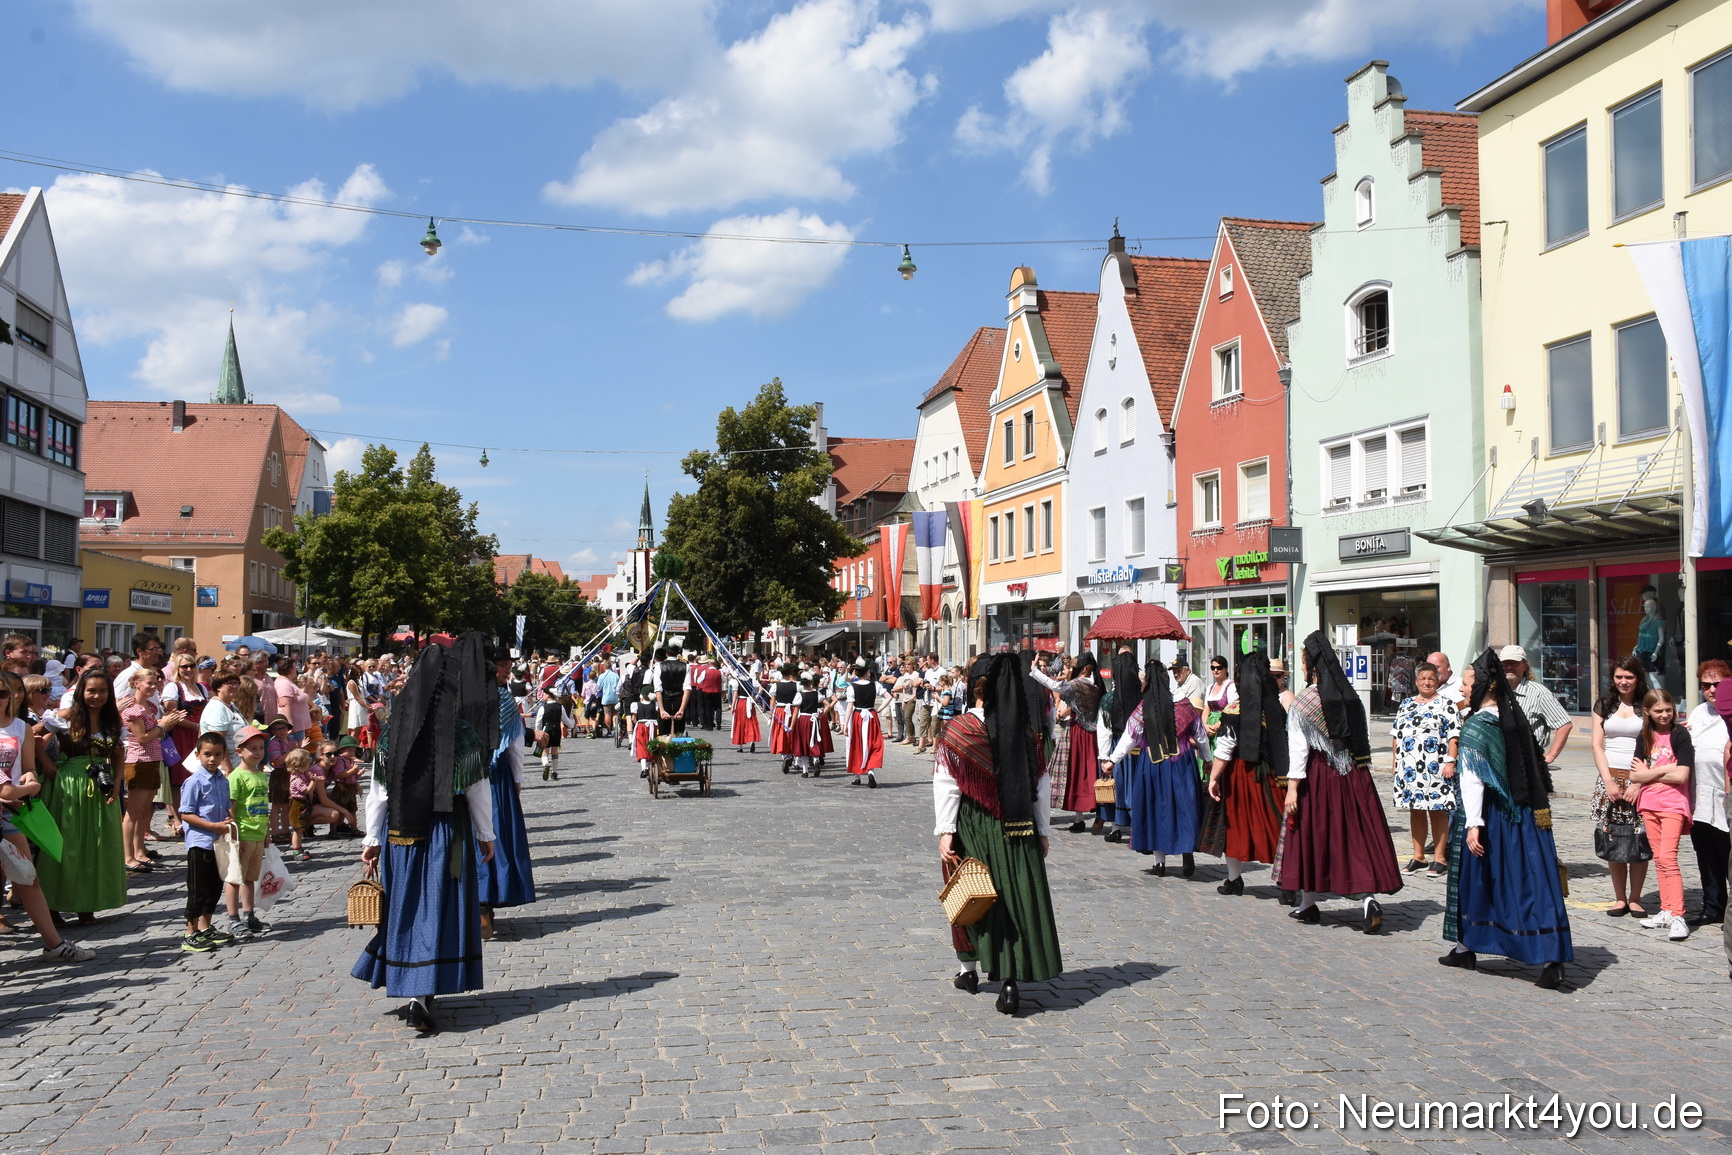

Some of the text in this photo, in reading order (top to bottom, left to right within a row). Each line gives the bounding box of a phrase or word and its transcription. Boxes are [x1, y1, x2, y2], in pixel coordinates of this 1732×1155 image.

[1355, 536, 1385, 551] BONITA
[1273, 546, 1299, 555] BONITA
[1234, 566, 1258, 579] debitel
[86, 594, 107, 602] APOLLO
[1358, 658, 1366, 670] P
